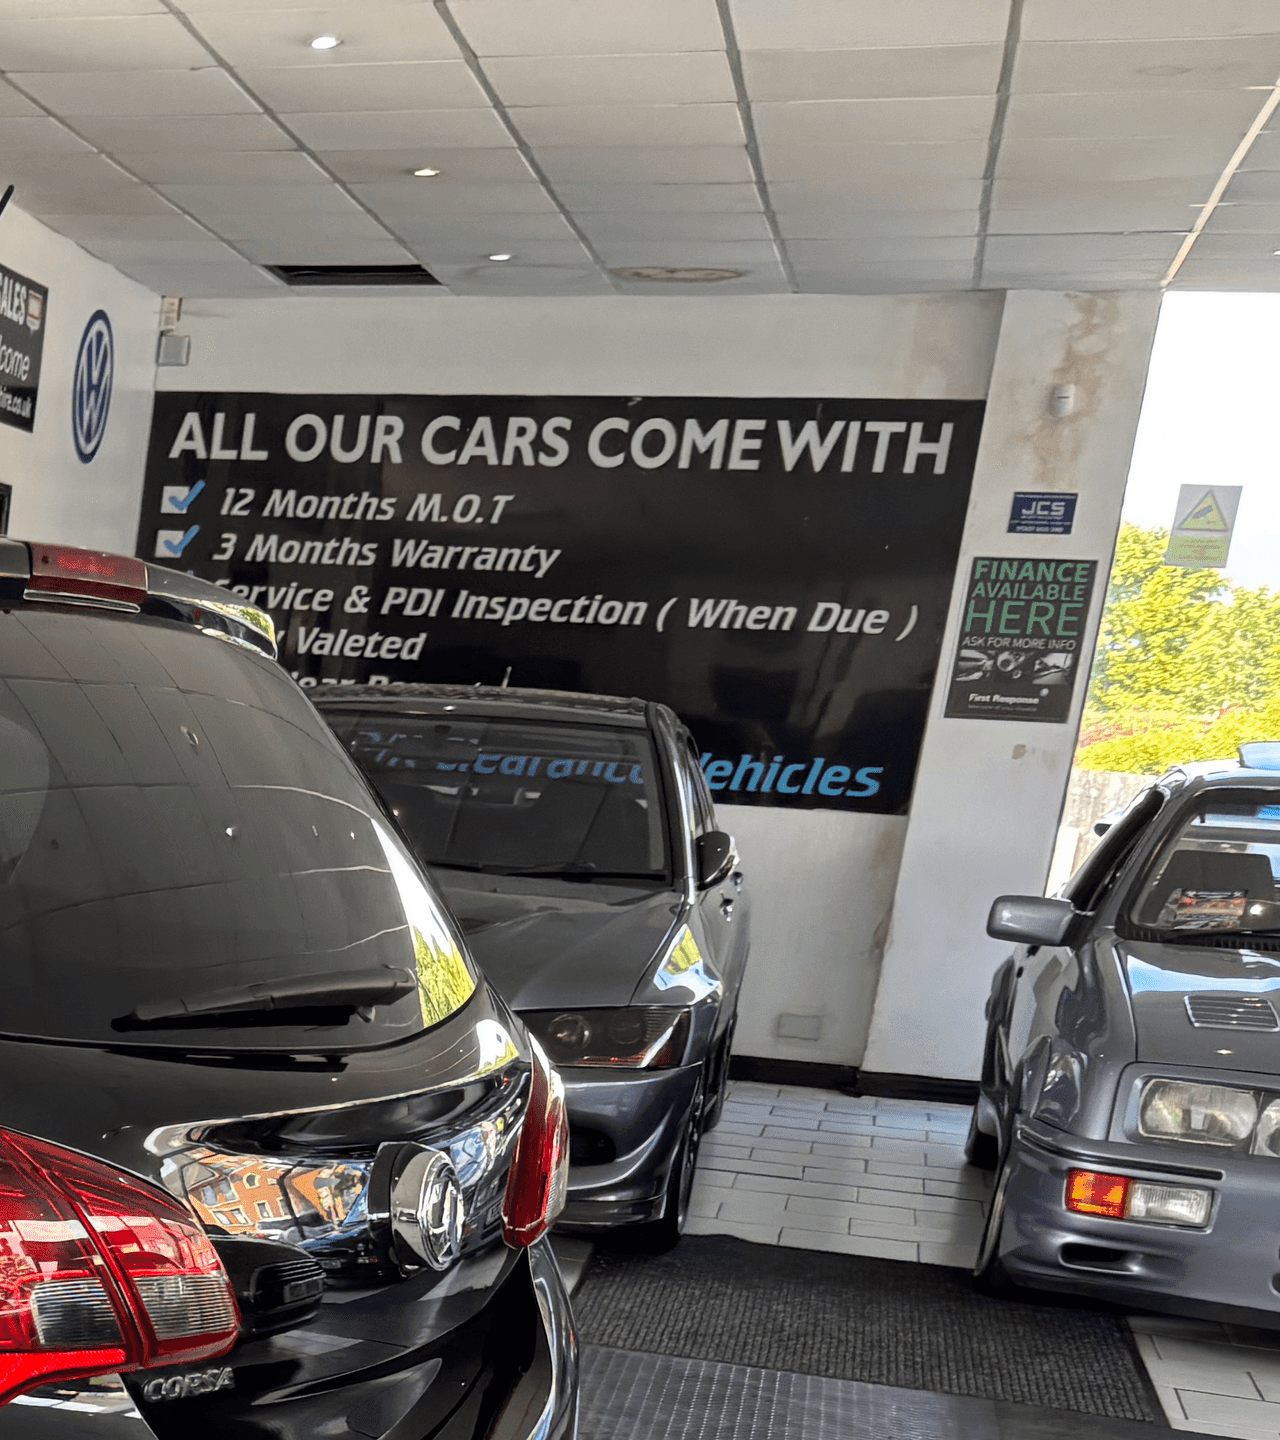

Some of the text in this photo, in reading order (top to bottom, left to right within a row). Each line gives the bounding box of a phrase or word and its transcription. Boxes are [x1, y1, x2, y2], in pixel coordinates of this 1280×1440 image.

[168, 412, 954, 474] ALL OUR CARS COME WITH
[220, 487, 515, 524] 12 Months M.O.T
[1022, 501, 1066, 515] JCS
[212, 533, 561, 578] 3 Months Warranty
[974, 561, 1090, 582] FINANCE
[971, 582, 1086, 600] AVAILABLE
[343, 585, 371, 614] &
[380, 587, 446, 616] PDI
[451, 590, 648, 626] Inspection
[687, 598, 798, 631] When
[807, 602, 889, 634] Due
[965, 600, 1083, 636] HERE
[297, 627, 427, 660] Valeted
[962, 636, 1077, 650] ASK FOR MORE INFO
[143, 1367, 235, 1402] CORSA
